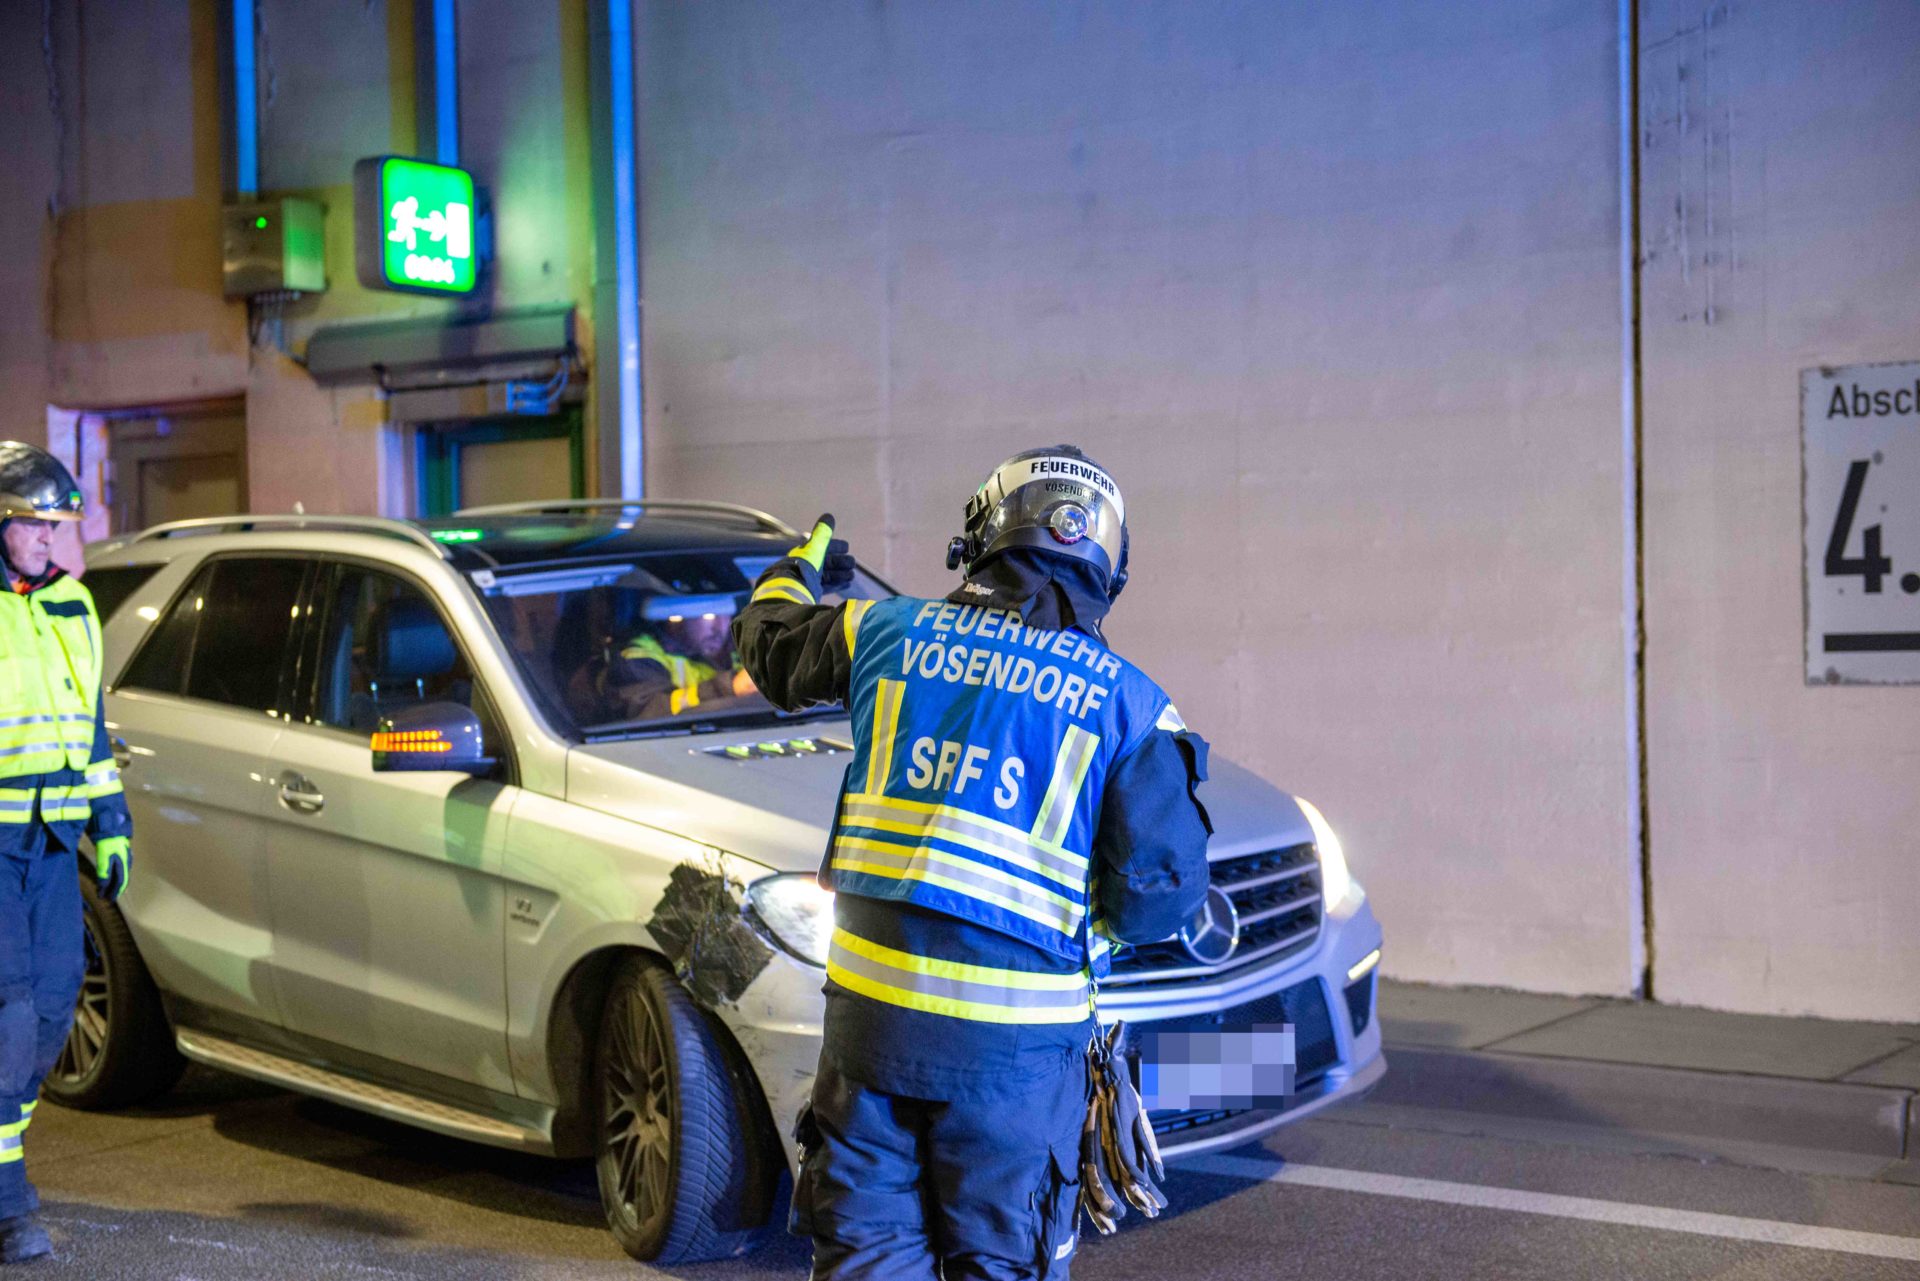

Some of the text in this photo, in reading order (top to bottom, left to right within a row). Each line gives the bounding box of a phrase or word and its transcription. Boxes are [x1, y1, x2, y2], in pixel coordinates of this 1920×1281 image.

[1031, 461, 1115, 496] FEUERWEHR
[902, 633, 1109, 720] VÖSENDORF
[913, 601, 1123, 680] FEUERWEHR
[906, 736, 1025, 810] SRF S
